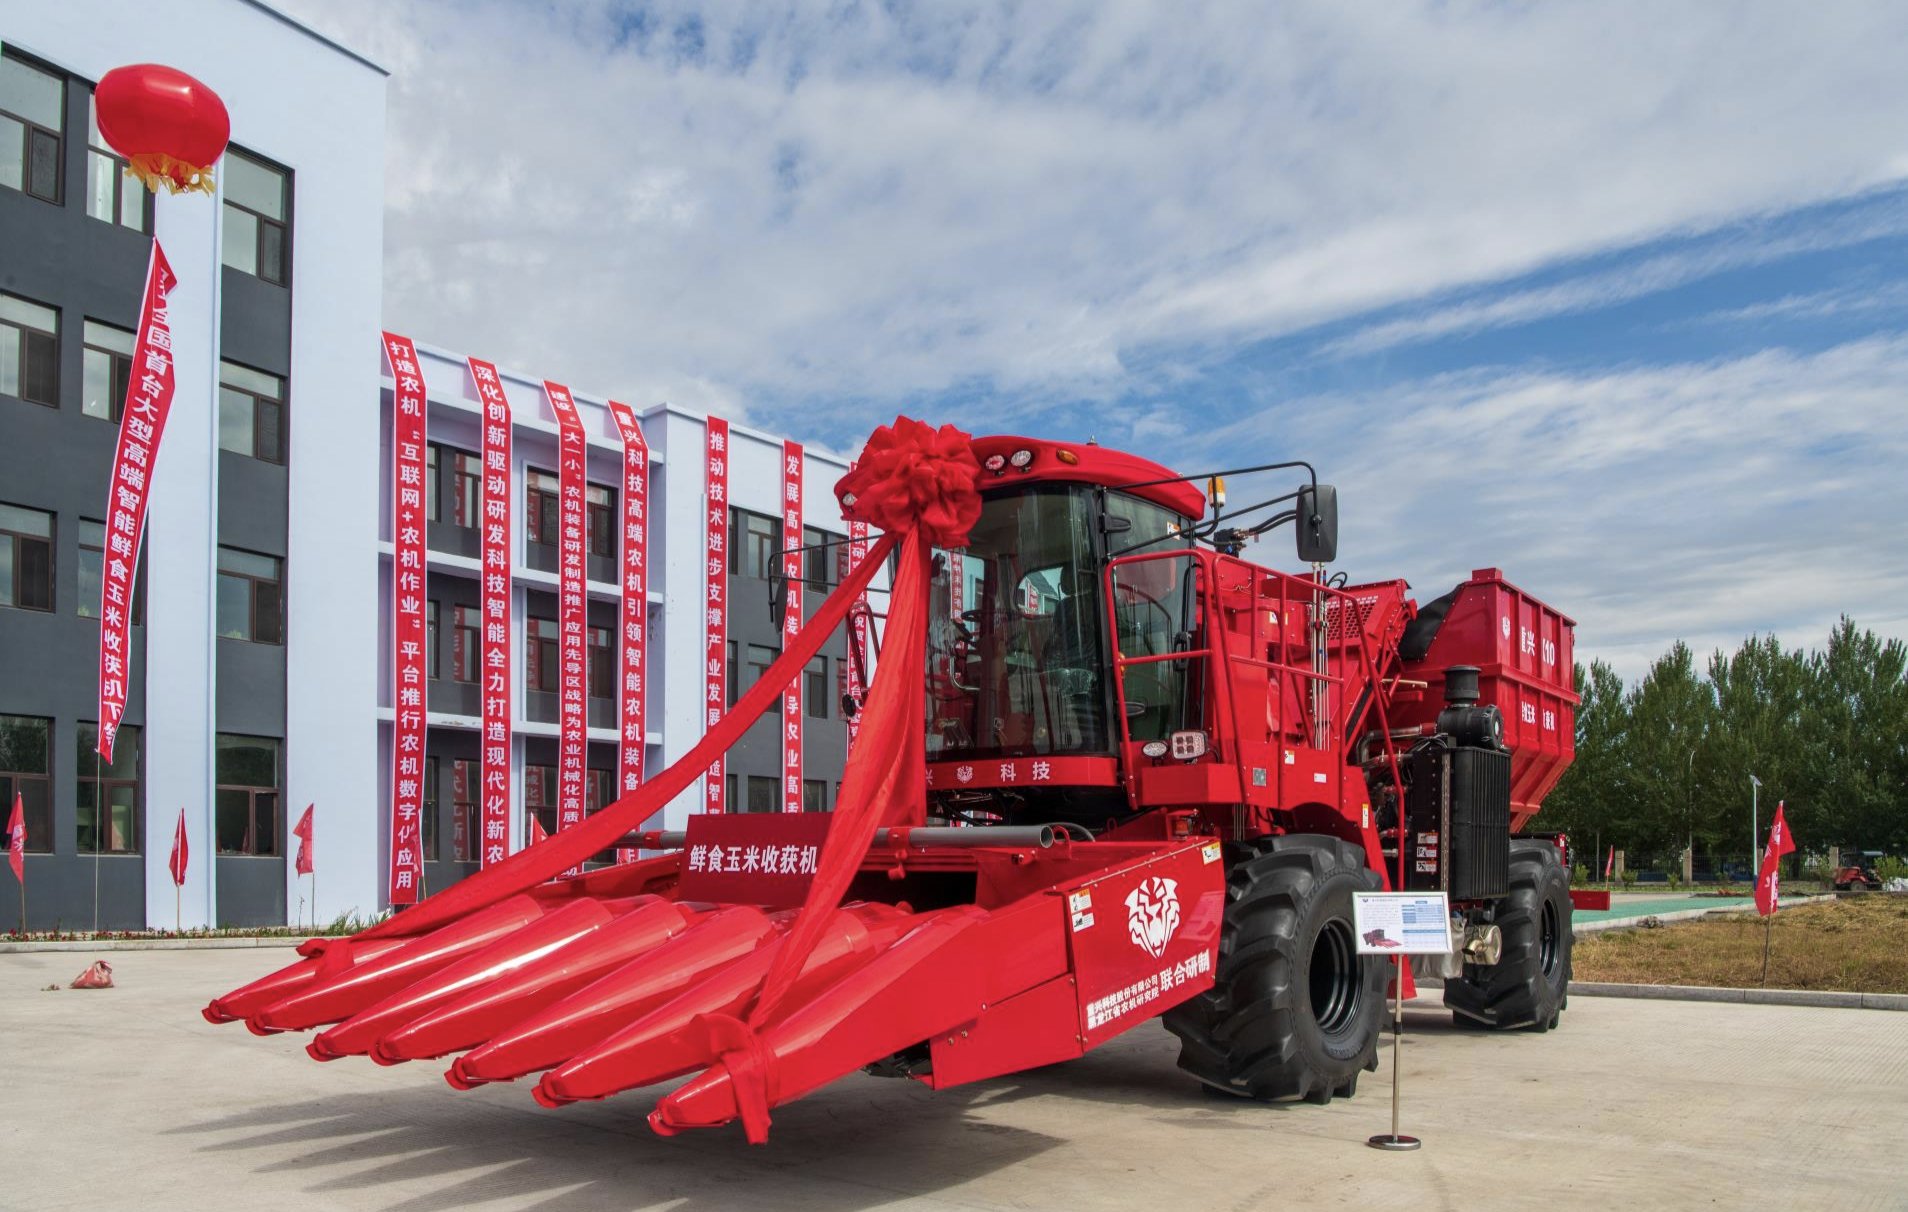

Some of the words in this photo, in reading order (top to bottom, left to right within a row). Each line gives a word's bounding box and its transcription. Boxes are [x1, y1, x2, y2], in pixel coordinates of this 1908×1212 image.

[1000, 761, 1051, 782] 科技
[688, 844, 818, 875] 鲜食玉米收获机
[1160, 949, 1211, 992] 联合研制
